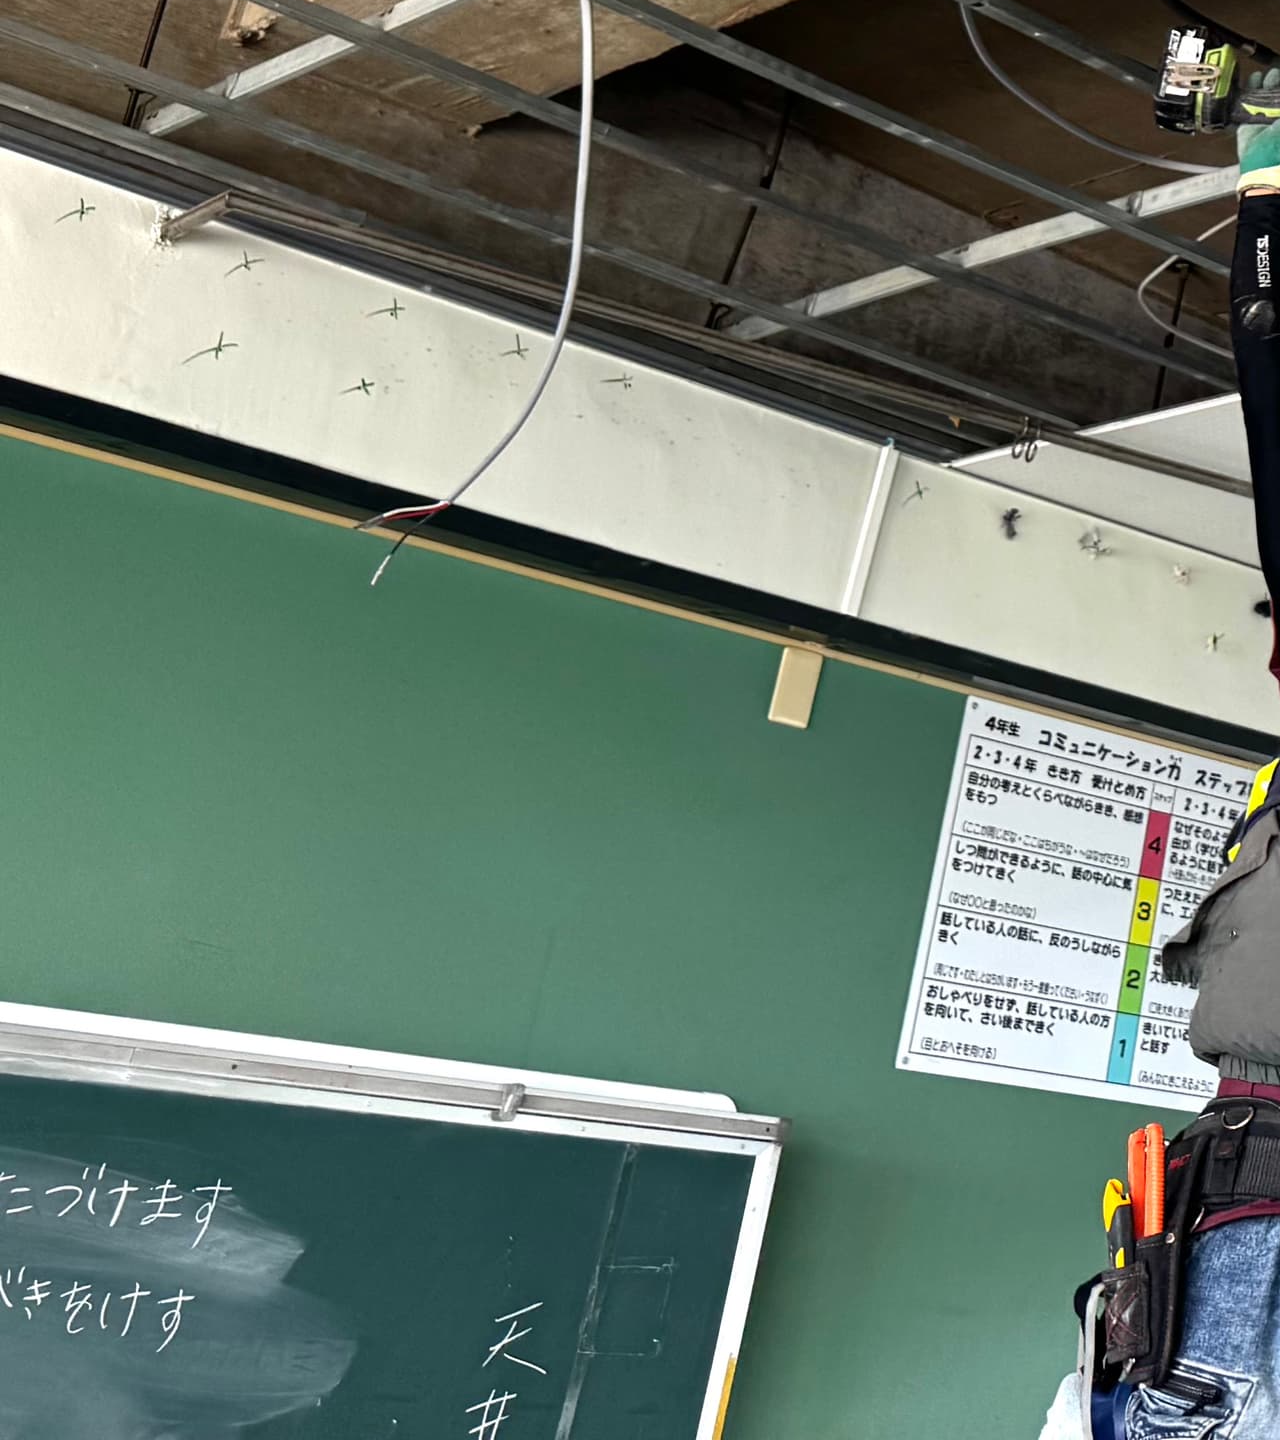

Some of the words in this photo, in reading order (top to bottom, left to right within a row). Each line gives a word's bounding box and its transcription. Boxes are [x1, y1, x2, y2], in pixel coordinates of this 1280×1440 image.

[1256, 234, 1272, 288] TSDESIGN
[985, 716, 1021, 738] 4年生
[1038, 730, 1182, 781] コミュニケーション力
[973, 745, 1037, 772] 2・3・4年
[1047, 763, 1082, 784] きき方
[1091, 774, 1148, 800] 受けとめ方
[965, 787, 998, 806] をもつ
[1148, 836, 1162, 855] 4
[952, 858, 1016, 884] をつけてきく
[1137, 901, 1152, 921] 3
[938, 930, 960, 945] きく
[1126, 969, 1142, 990] 2
[927, 985, 1111, 1028] おしゃべりをせず、話している人の方
[924, 1002, 1055, 1036] を向いて、さい後まできく
[1119, 1039, 1127, 1058] 1
[1140, 1040, 1170, 1055] と話す
